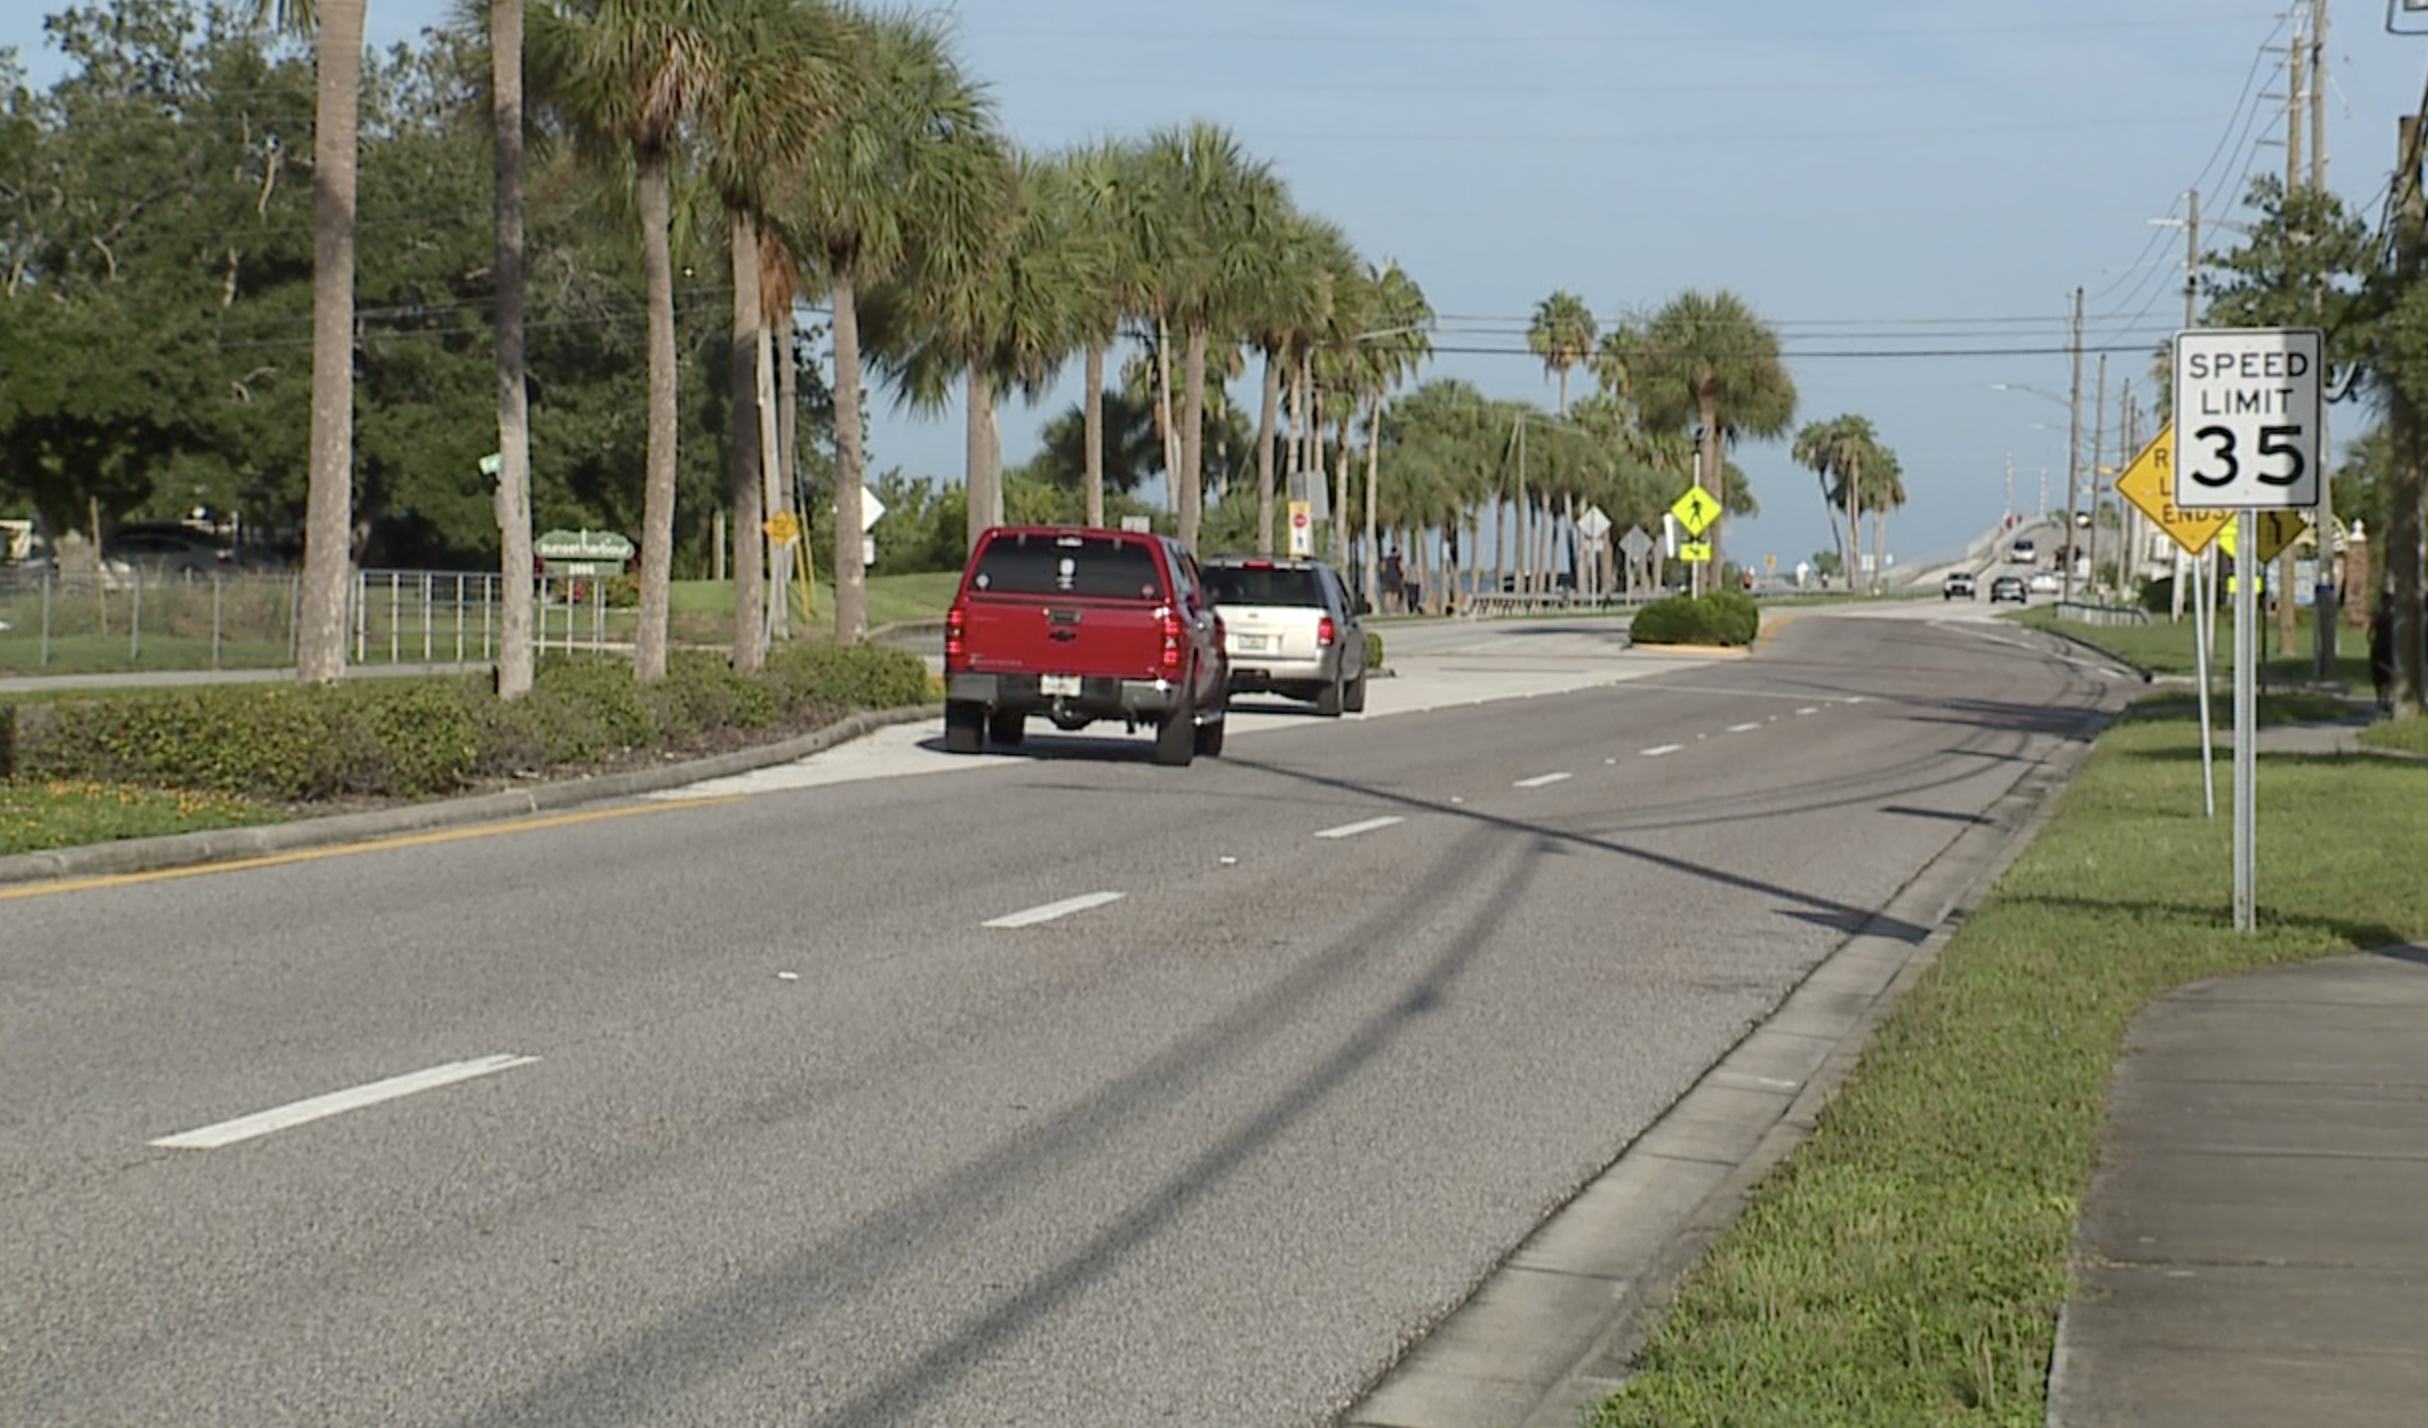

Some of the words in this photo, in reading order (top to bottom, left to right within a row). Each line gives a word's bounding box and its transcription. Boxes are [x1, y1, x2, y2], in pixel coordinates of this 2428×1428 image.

[2189, 352, 2308, 379] SPEED
[2201, 387, 2294, 415] LIMIT
[2191, 425, 2305, 488] 35
